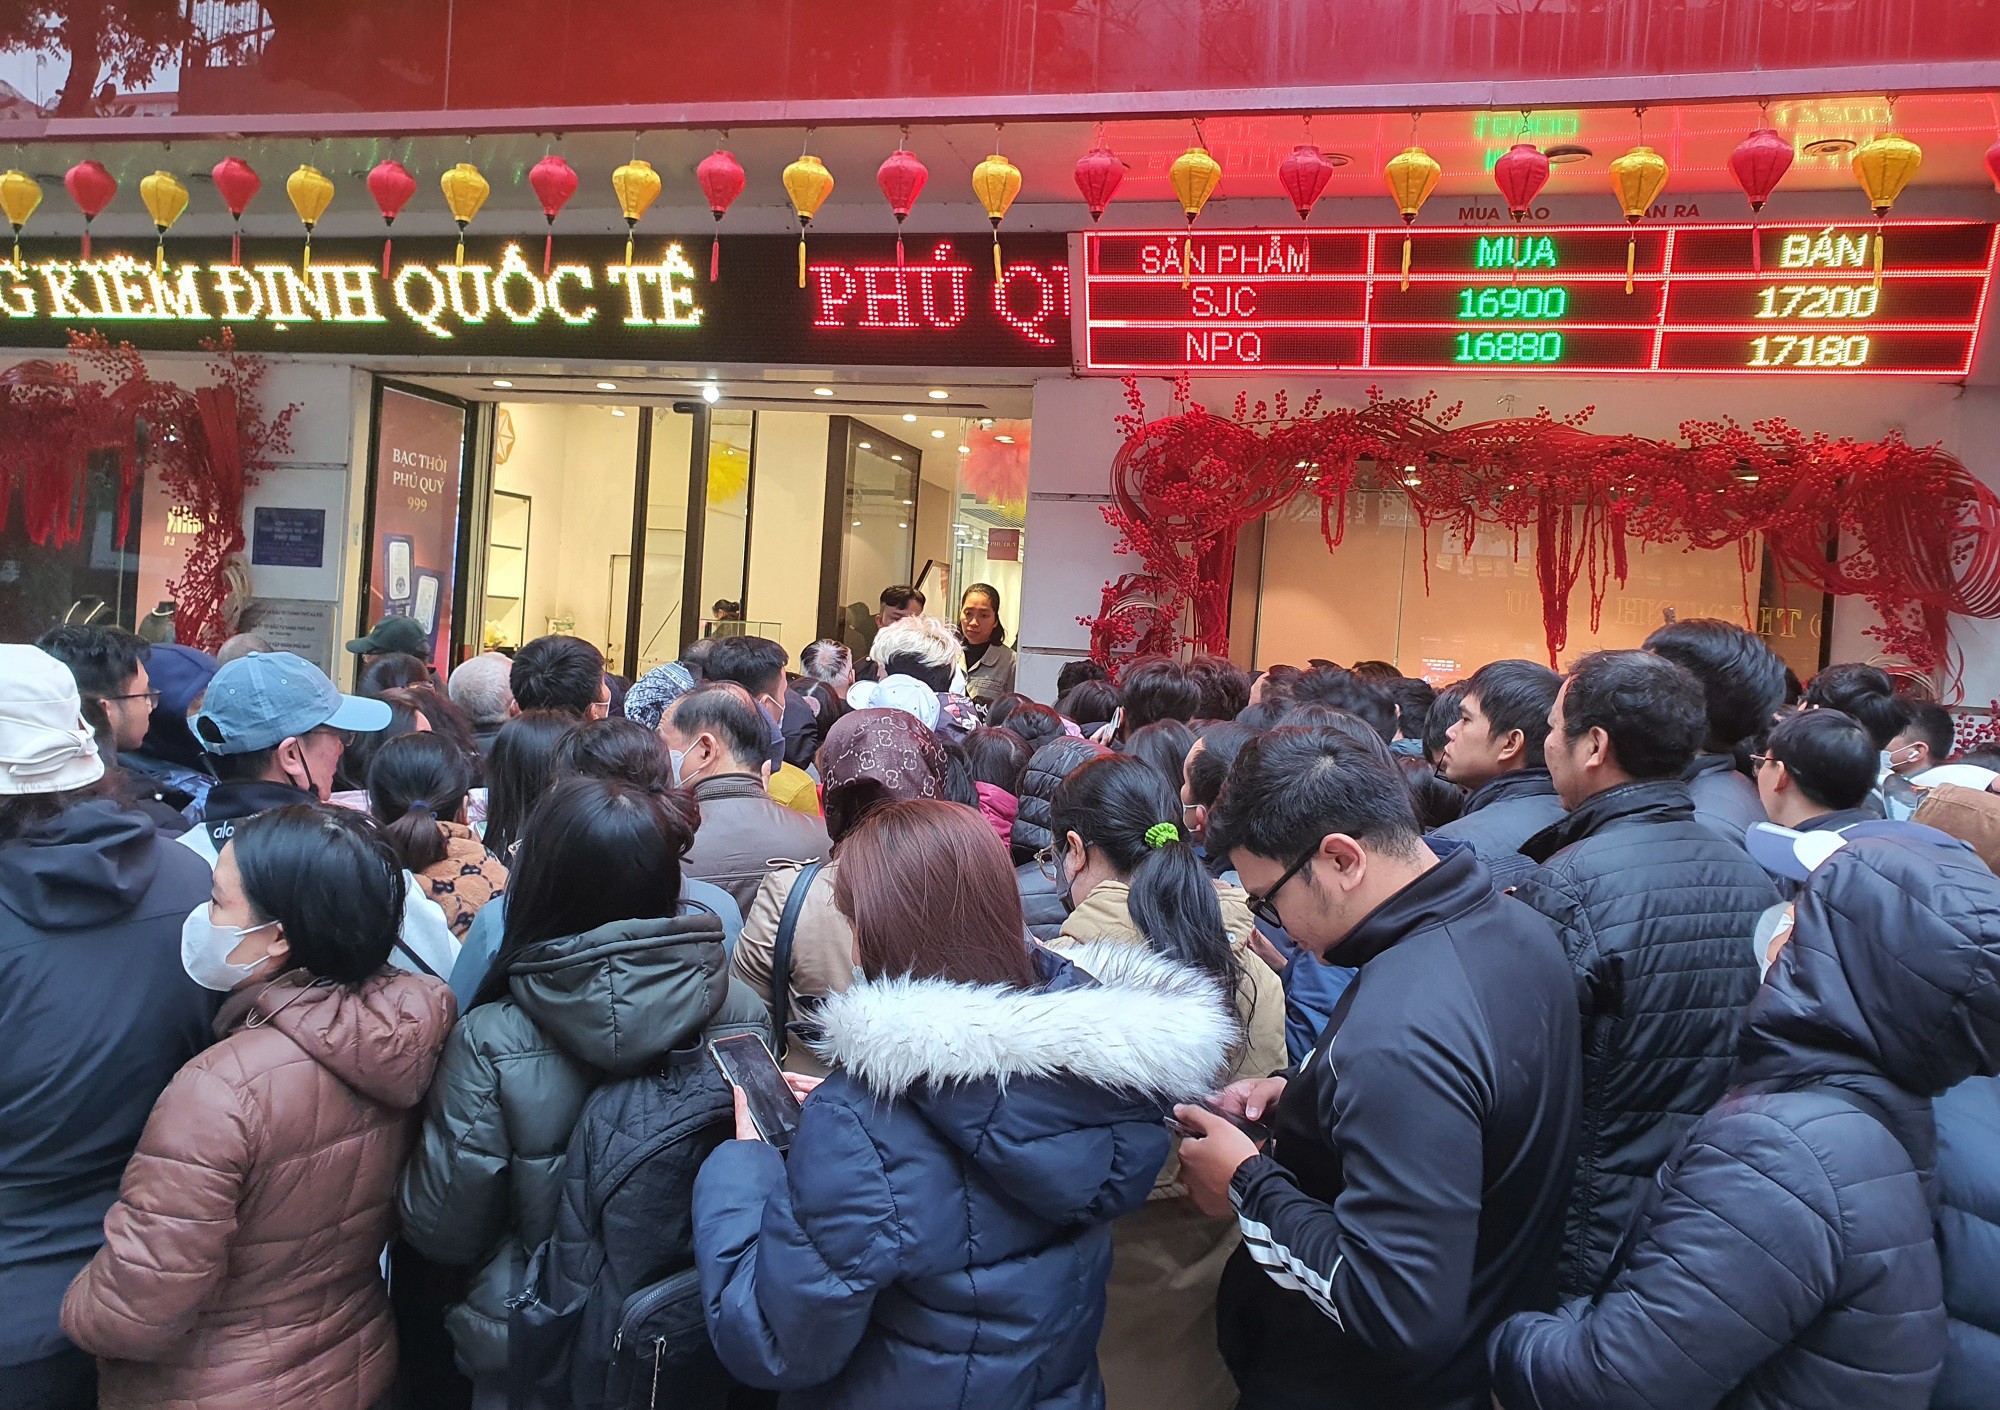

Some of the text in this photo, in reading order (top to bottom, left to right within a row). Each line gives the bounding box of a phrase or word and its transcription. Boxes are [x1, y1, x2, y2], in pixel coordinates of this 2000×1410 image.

[1459, 207, 1500, 220] MUA
[1673, 204, 1699, 218] RA
[1477, 235, 1556, 268] MUA
[1779, 225, 1868, 268] BÁN
[209, 265, 388, 331] ĐỊNH
[393, 244, 597, 338] QUỐC
[606, 244, 704, 325] TẾ
[1192, 286, 1256, 316] SJC
[1458, 287, 1566, 318] 16900
[1754, 285, 1879, 318] 17200
[1186, 331, 1261, 361] NPQ
[1455, 331, 1562, 361] 16880
[1747, 335, 1870, 366] 17180
[392, 448, 417, 468] BẠC
[407, 496, 428, 513] 999
[213, 820, 234, 839] alo
